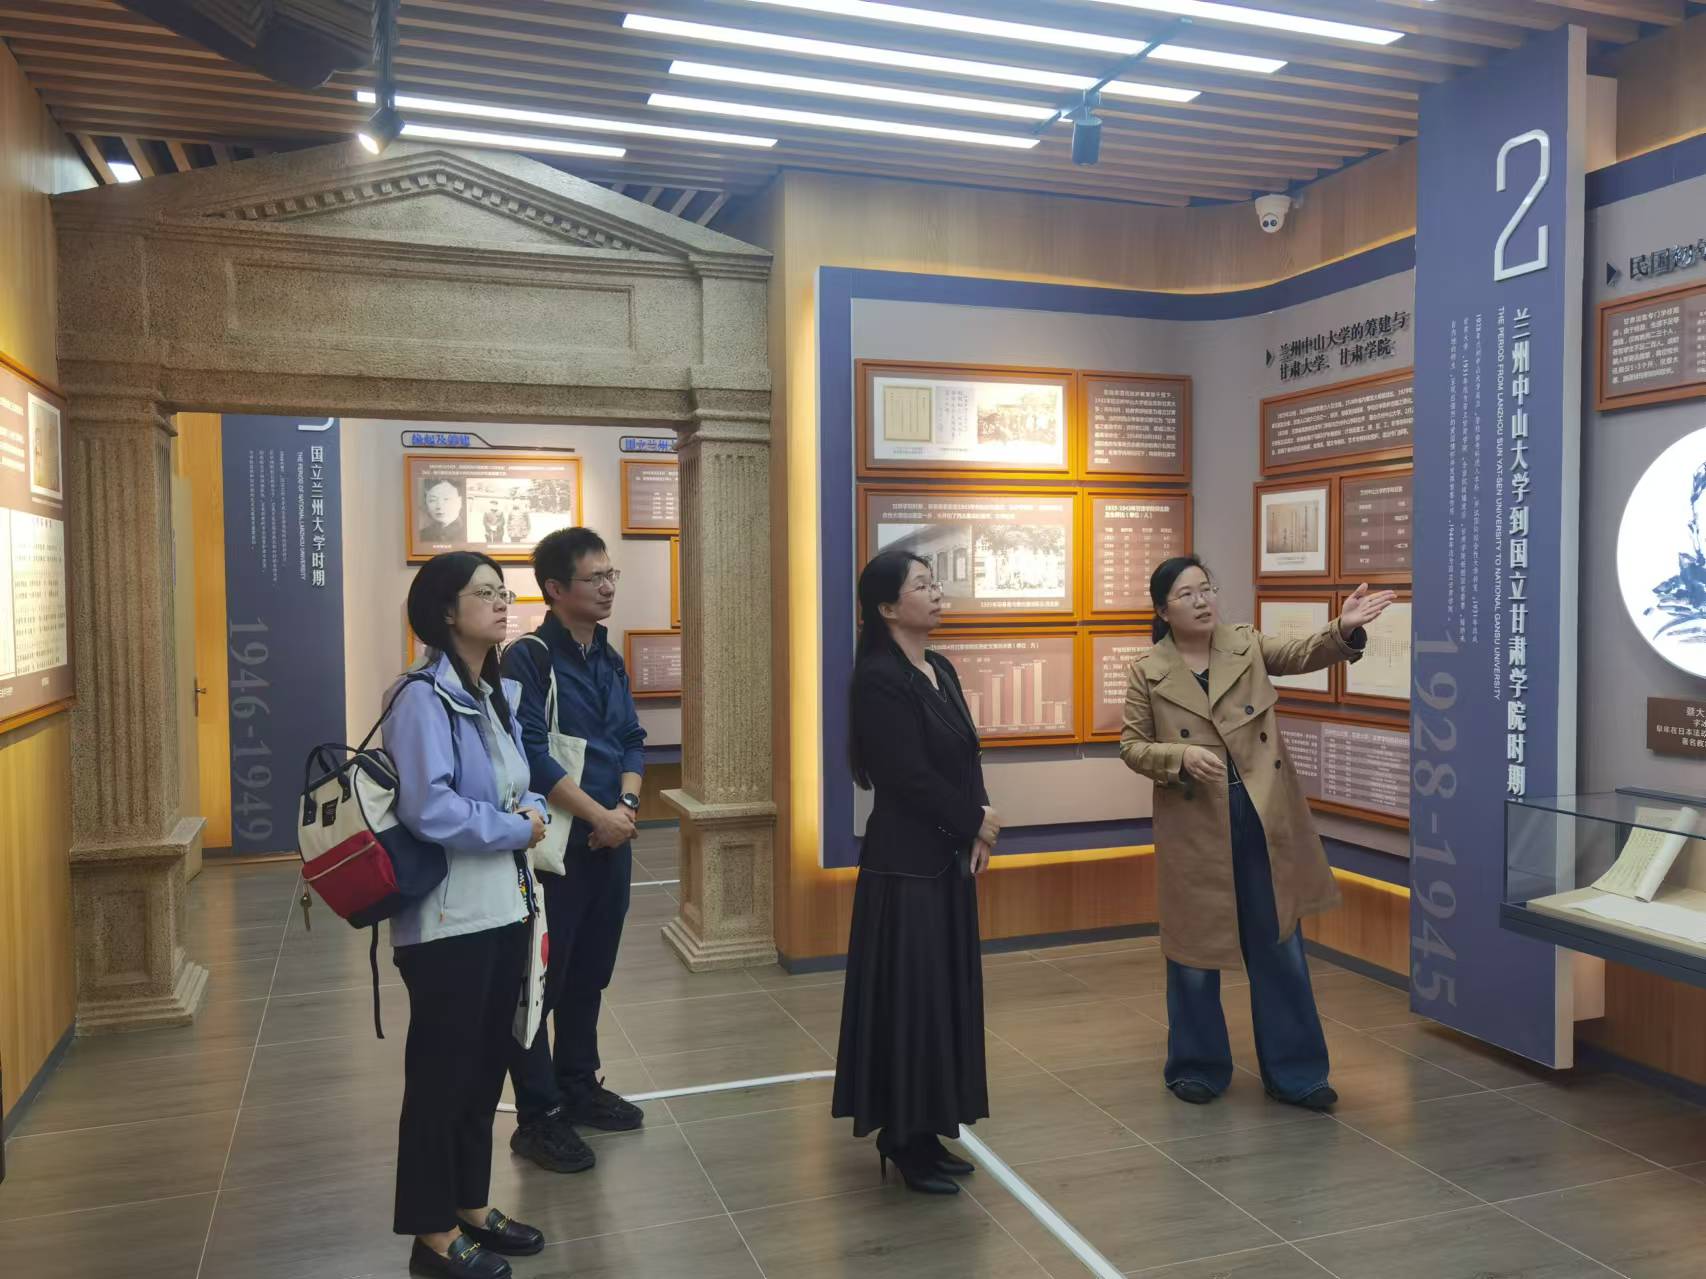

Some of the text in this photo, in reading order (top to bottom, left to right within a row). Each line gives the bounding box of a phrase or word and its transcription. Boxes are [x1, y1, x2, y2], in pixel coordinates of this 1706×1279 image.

[1494, 129, 1550, 281] 2
[1280, 311, 1408, 359] 兰州中山大学的筹建与
[1496, 306, 1504, 325] THE
[1496, 327, 1504, 362] PERIOD
[1496, 392, 1504, 435] LANZHOU
[1495, 459, 1503, 496] YAT-SEN
[310, 445, 326, 586] 国立兰州大学时期
[1495, 498, 1503, 551] UNIVERSITY
[1494, 553, 1502, 566] TO
[1507, 307, 1531, 796] 兰州中山大学到国立甘肃学院时期
[1494, 568, 1502, 612] NATIONAL
[1493, 614, 1501, 645] GANSU
[1493, 647, 1501, 700] UNIVERSITY
[229, 617, 272, 841] 1946-1949
[1412, 630, 1459, 1007] 1928-1945
